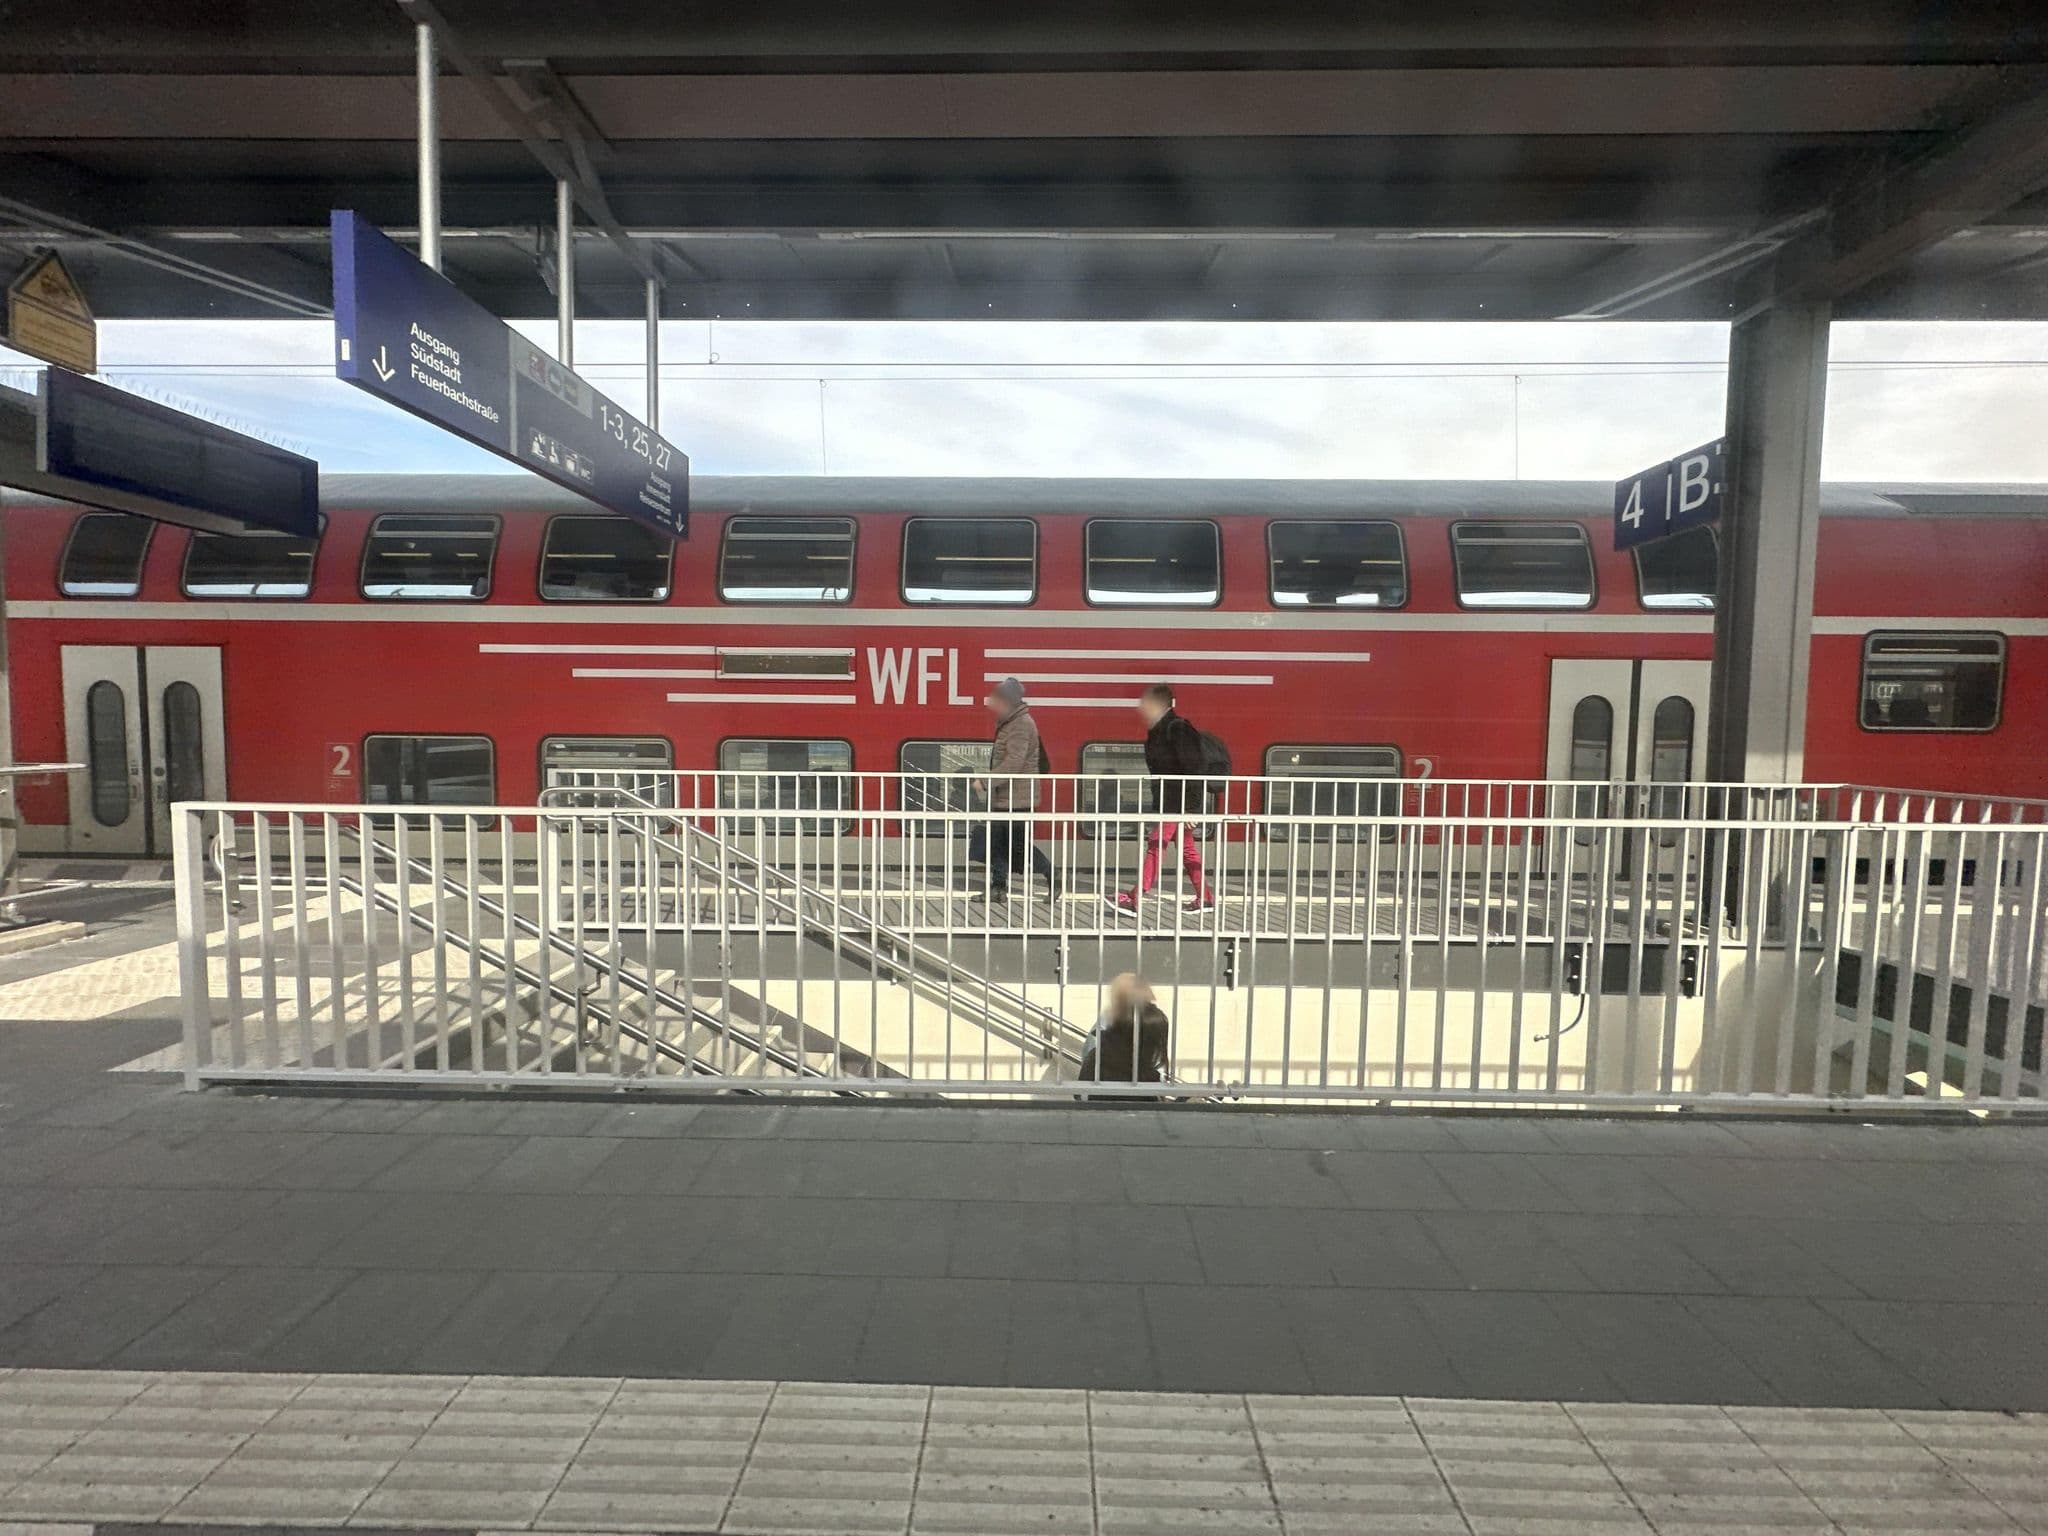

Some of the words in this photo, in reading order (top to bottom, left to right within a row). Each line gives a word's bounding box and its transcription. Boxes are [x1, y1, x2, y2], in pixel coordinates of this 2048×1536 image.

[410, 322, 460, 366] Ausgang
[410, 342, 462, 384] Südstadt
[411, 363, 499, 423] Feuerbachstraße
[600, 404, 628, 449] 1-3,
[632, 426, 652, 465] 25,
[656, 442, 671, 471] 27
[1621, 479, 1645, 529] 4
[1679, 454, 1710, 513] B
[866, 647, 974, 706] WFL
[332, 745, 352, 776] 2
[1413, 757, 1433, 789] 2
